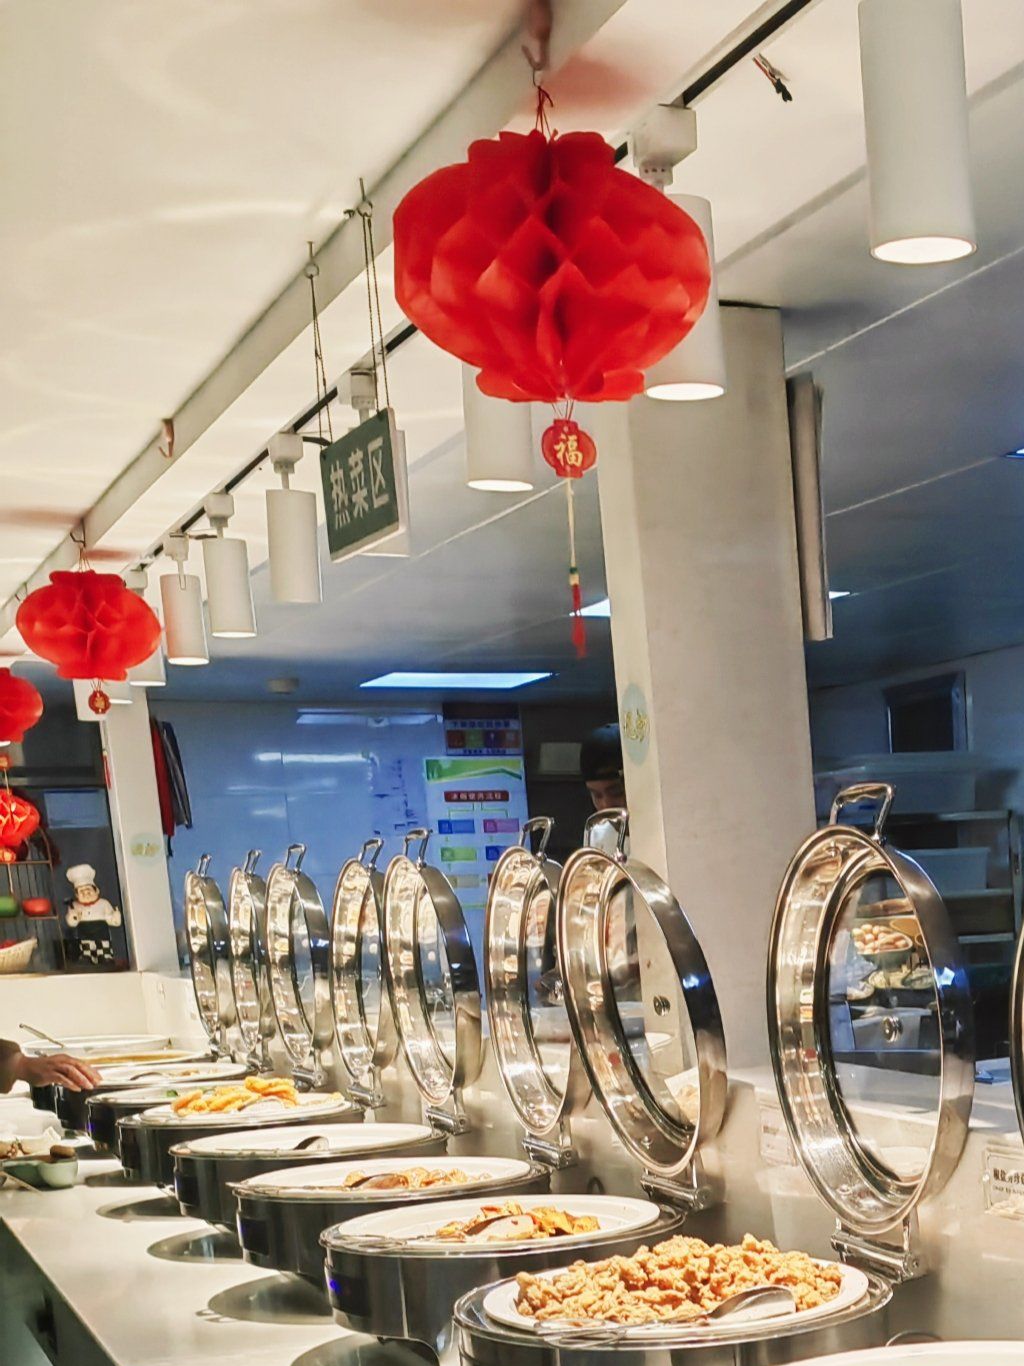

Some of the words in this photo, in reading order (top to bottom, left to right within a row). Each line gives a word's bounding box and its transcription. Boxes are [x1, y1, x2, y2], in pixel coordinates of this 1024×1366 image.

[553, 433, 584, 468] 福
[329, 436, 390, 531] 热菜区
